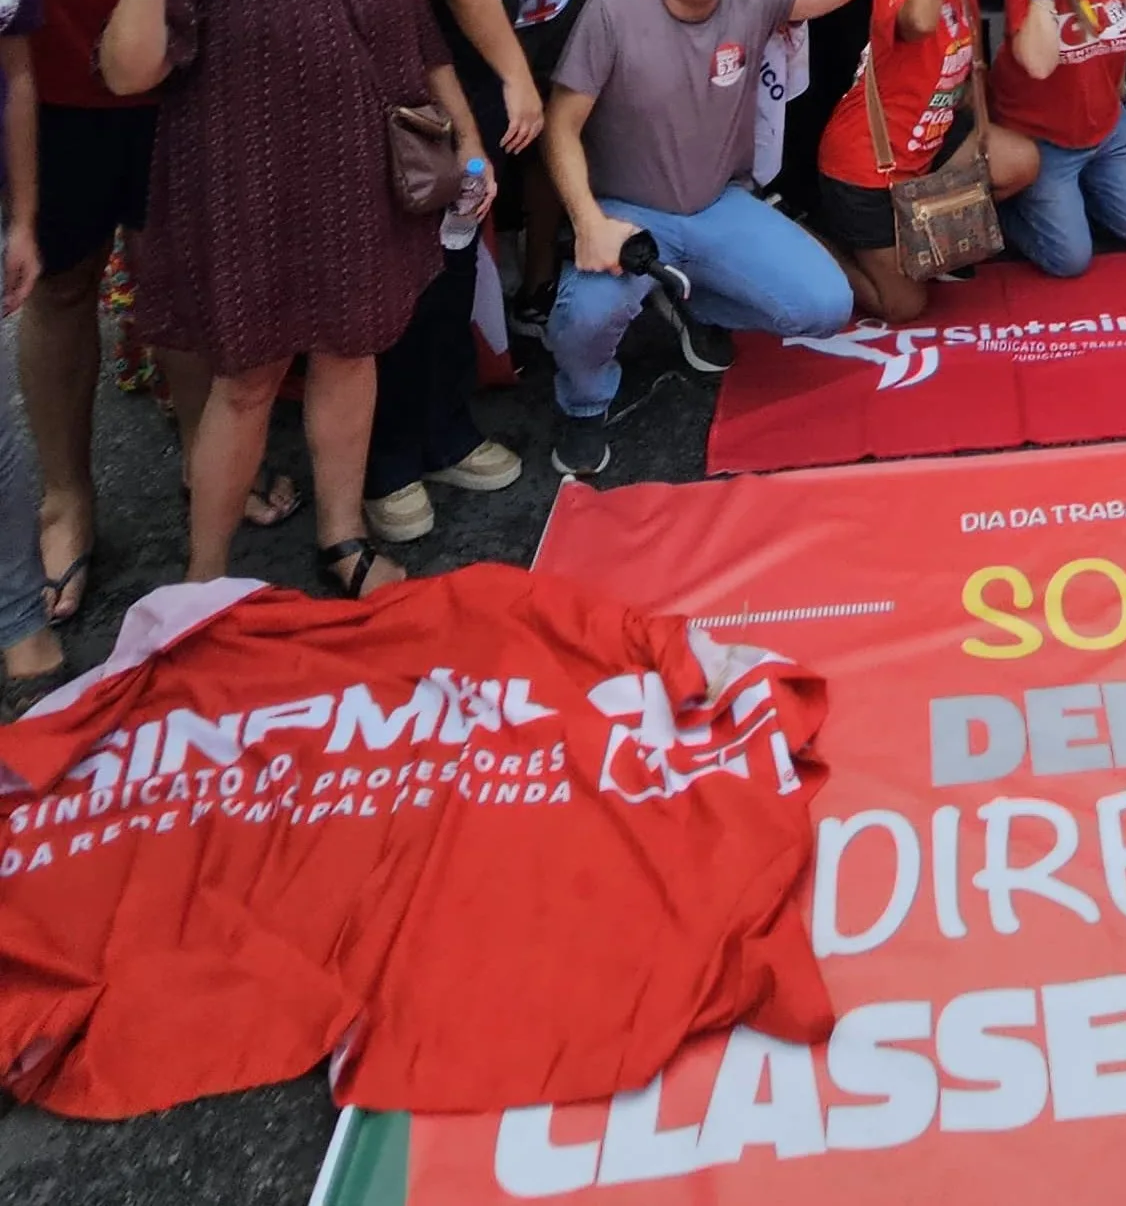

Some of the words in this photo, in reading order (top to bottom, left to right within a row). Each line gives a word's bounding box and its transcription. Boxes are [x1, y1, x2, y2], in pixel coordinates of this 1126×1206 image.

[976, 339, 1046, 353] SINDICATO
[960, 510, 1006, 534] DIA
[1010, 507, 1048, 529] DA
[9, 764, 244, 834] SINDICATO
[0, 840, 53, 878] DA
